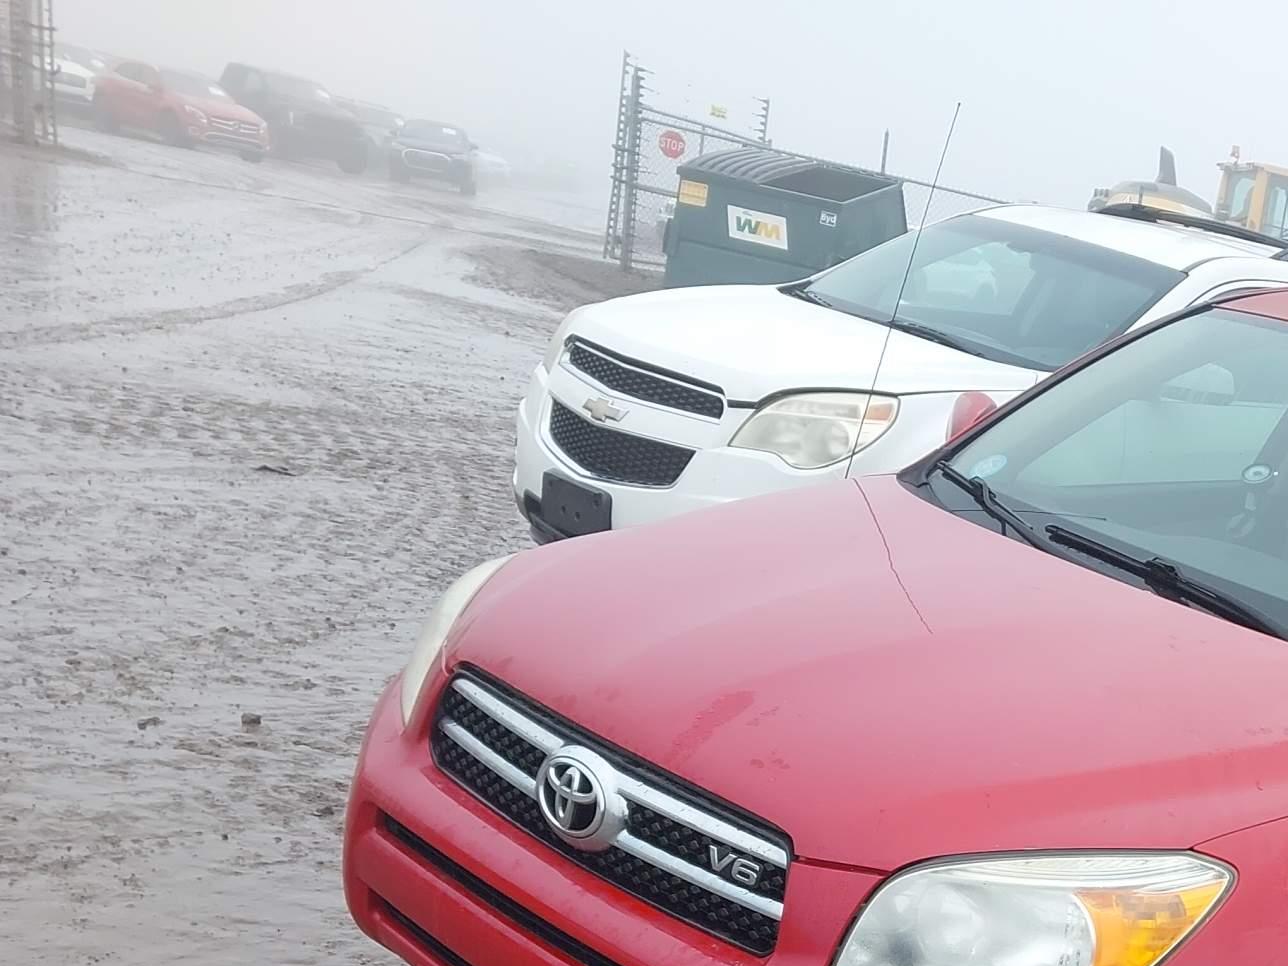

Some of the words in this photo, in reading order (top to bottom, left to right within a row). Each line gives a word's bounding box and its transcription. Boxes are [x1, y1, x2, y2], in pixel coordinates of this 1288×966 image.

[660, 137, 685, 153] STOP
[736, 215, 780, 240] WM
[708, 844, 761, 886] V6
